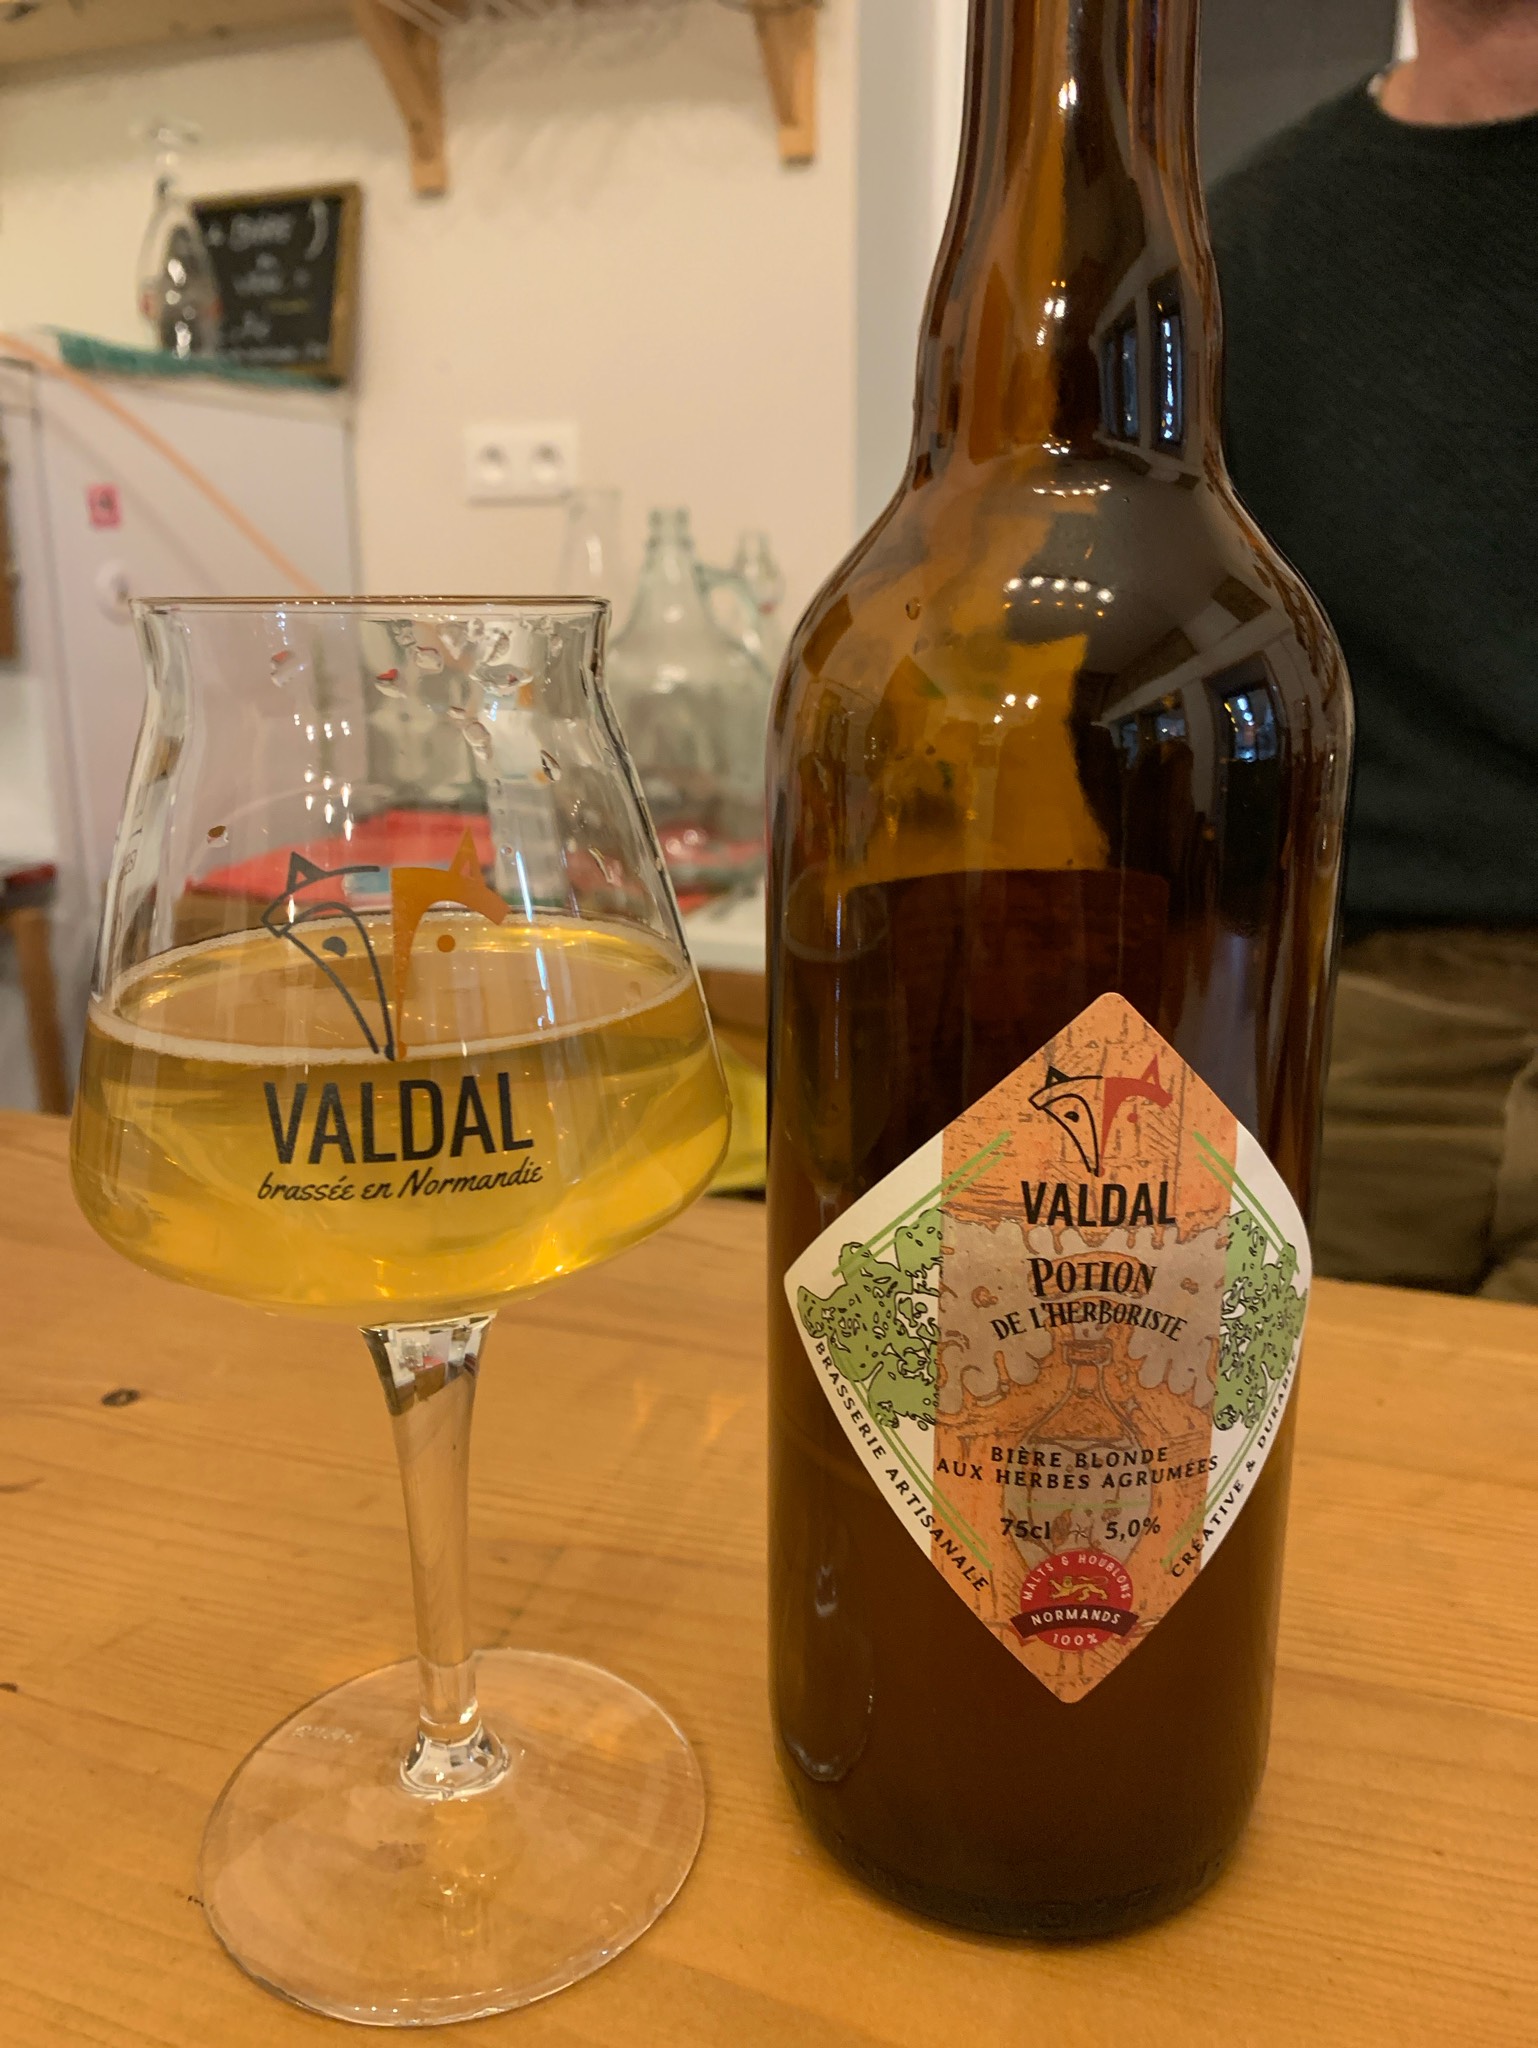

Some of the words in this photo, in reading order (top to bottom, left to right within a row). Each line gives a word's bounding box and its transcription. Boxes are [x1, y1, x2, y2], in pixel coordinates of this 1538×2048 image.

[263, 1072, 534, 1165] VALDAL
[257, 1172, 355, 1201] brassée
[361, 1182, 393, 1200] en
[397, 1156, 544, 1199] Normandie
[1021, 1180, 1176, 1227] VALDAL
[1027, 1257, 1157, 1297] POTION
[989, 1311, 1027, 1341] DE
[1028, 1300, 1188, 1342] L'HERBORISTE
[815, 1341, 887, 1460] BRASSERIE
[885, 1468, 989, 1592] ARTISANALE
[936, 1458, 983, 1481] AUX
[995, 1469, 1090, 1489] HERBES
[1101, 1455, 1218, 1488] AGRUMÉES
[990, 1446, 1062, 1468] BIÈRE
[1075, 1447, 1168, 1468] BLONDE
[1000, 1517, 1051, 1540] 75cl
[1104, 1516, 1162, 1542] 5,0%
[1171, 1479, 1244, 1578] CRÉATIVE
[1246, 1459, 1256, 1473] &
[1022, 1562, 1054, 1601] MALTS
[1078, 1554, 1131, 1599] HOUBLONS
[1030, 1609, 1121, 1625] NORMANDS
[1053, 1633, 1098, 1646] 100%
